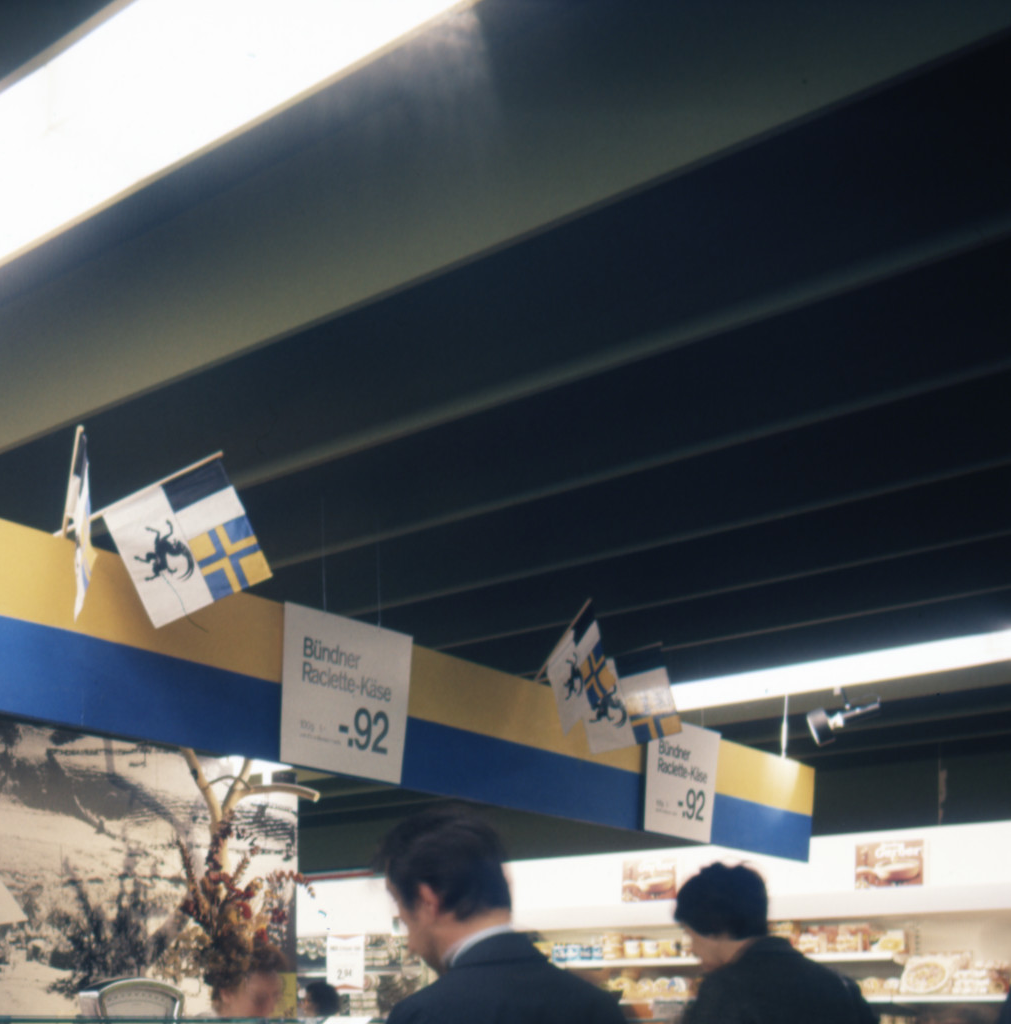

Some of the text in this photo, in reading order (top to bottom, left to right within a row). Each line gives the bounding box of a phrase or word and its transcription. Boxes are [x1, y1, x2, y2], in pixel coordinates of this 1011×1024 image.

[303, 636, 361, 670] Bündner
[302, 661, 392, 702] Raclette-Käse
[658, 740, 691, 761] Bündner
[657, 757, 708, 783] Raclette-Käse
